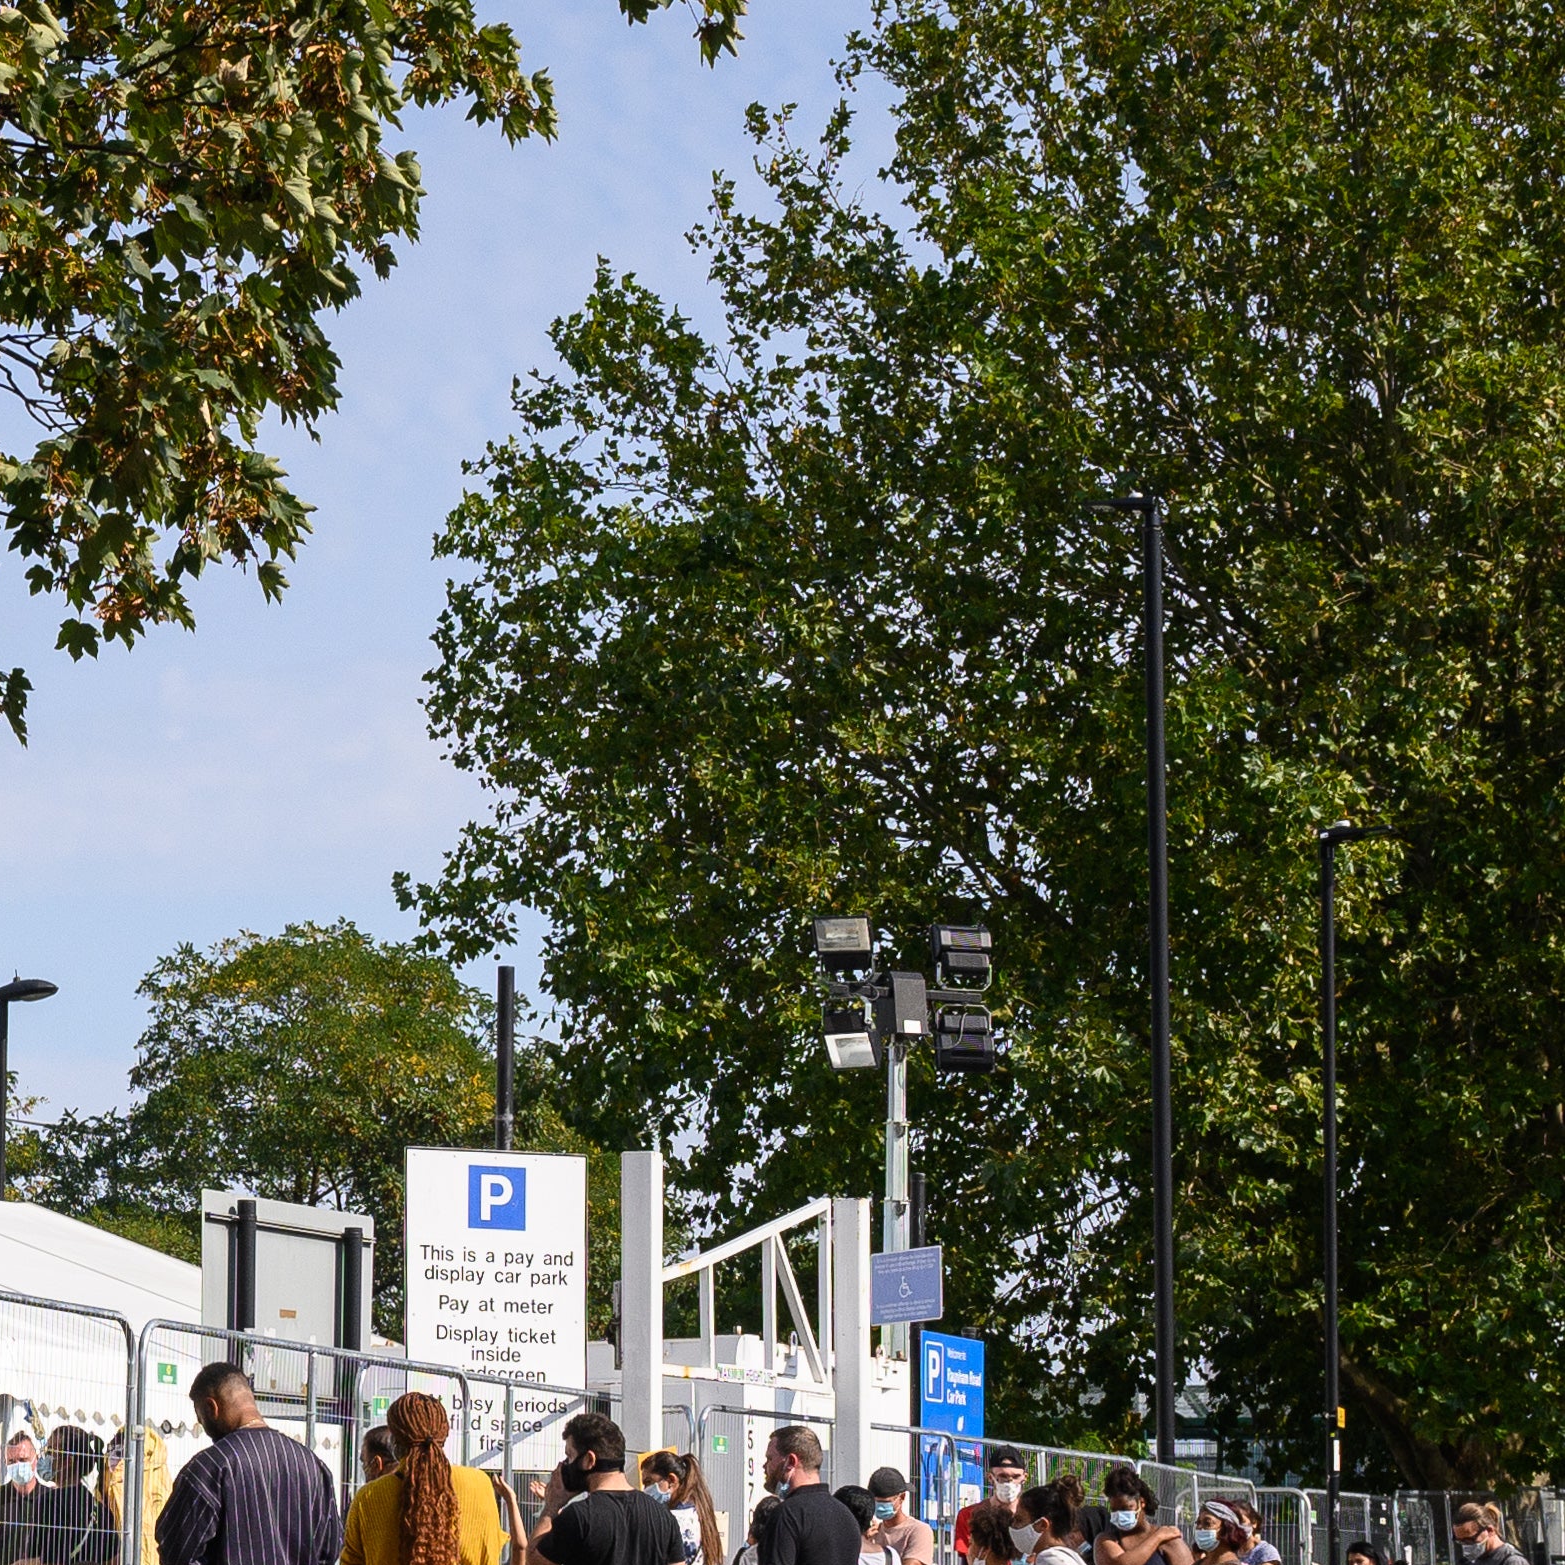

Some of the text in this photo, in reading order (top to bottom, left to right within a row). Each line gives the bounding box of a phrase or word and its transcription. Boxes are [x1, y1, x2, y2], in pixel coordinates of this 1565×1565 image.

[480, 1173, 513, 1221] P
[420, 1244, 574, 1268] This is a pay and
[424, 1265, 568, 1287] display car park
[438, 1294, 554, 1315] Pay at meter
[436, 1324, 557, 1345] Display ticket
[471, 1346, 522, 1363] inside
[928, 1349, 941, 1394] P
[503, 1397, 568, 1414] eriods
[450, 1414, 543, 1435] fid sace
[479, 1434, 505, 1452] firs
